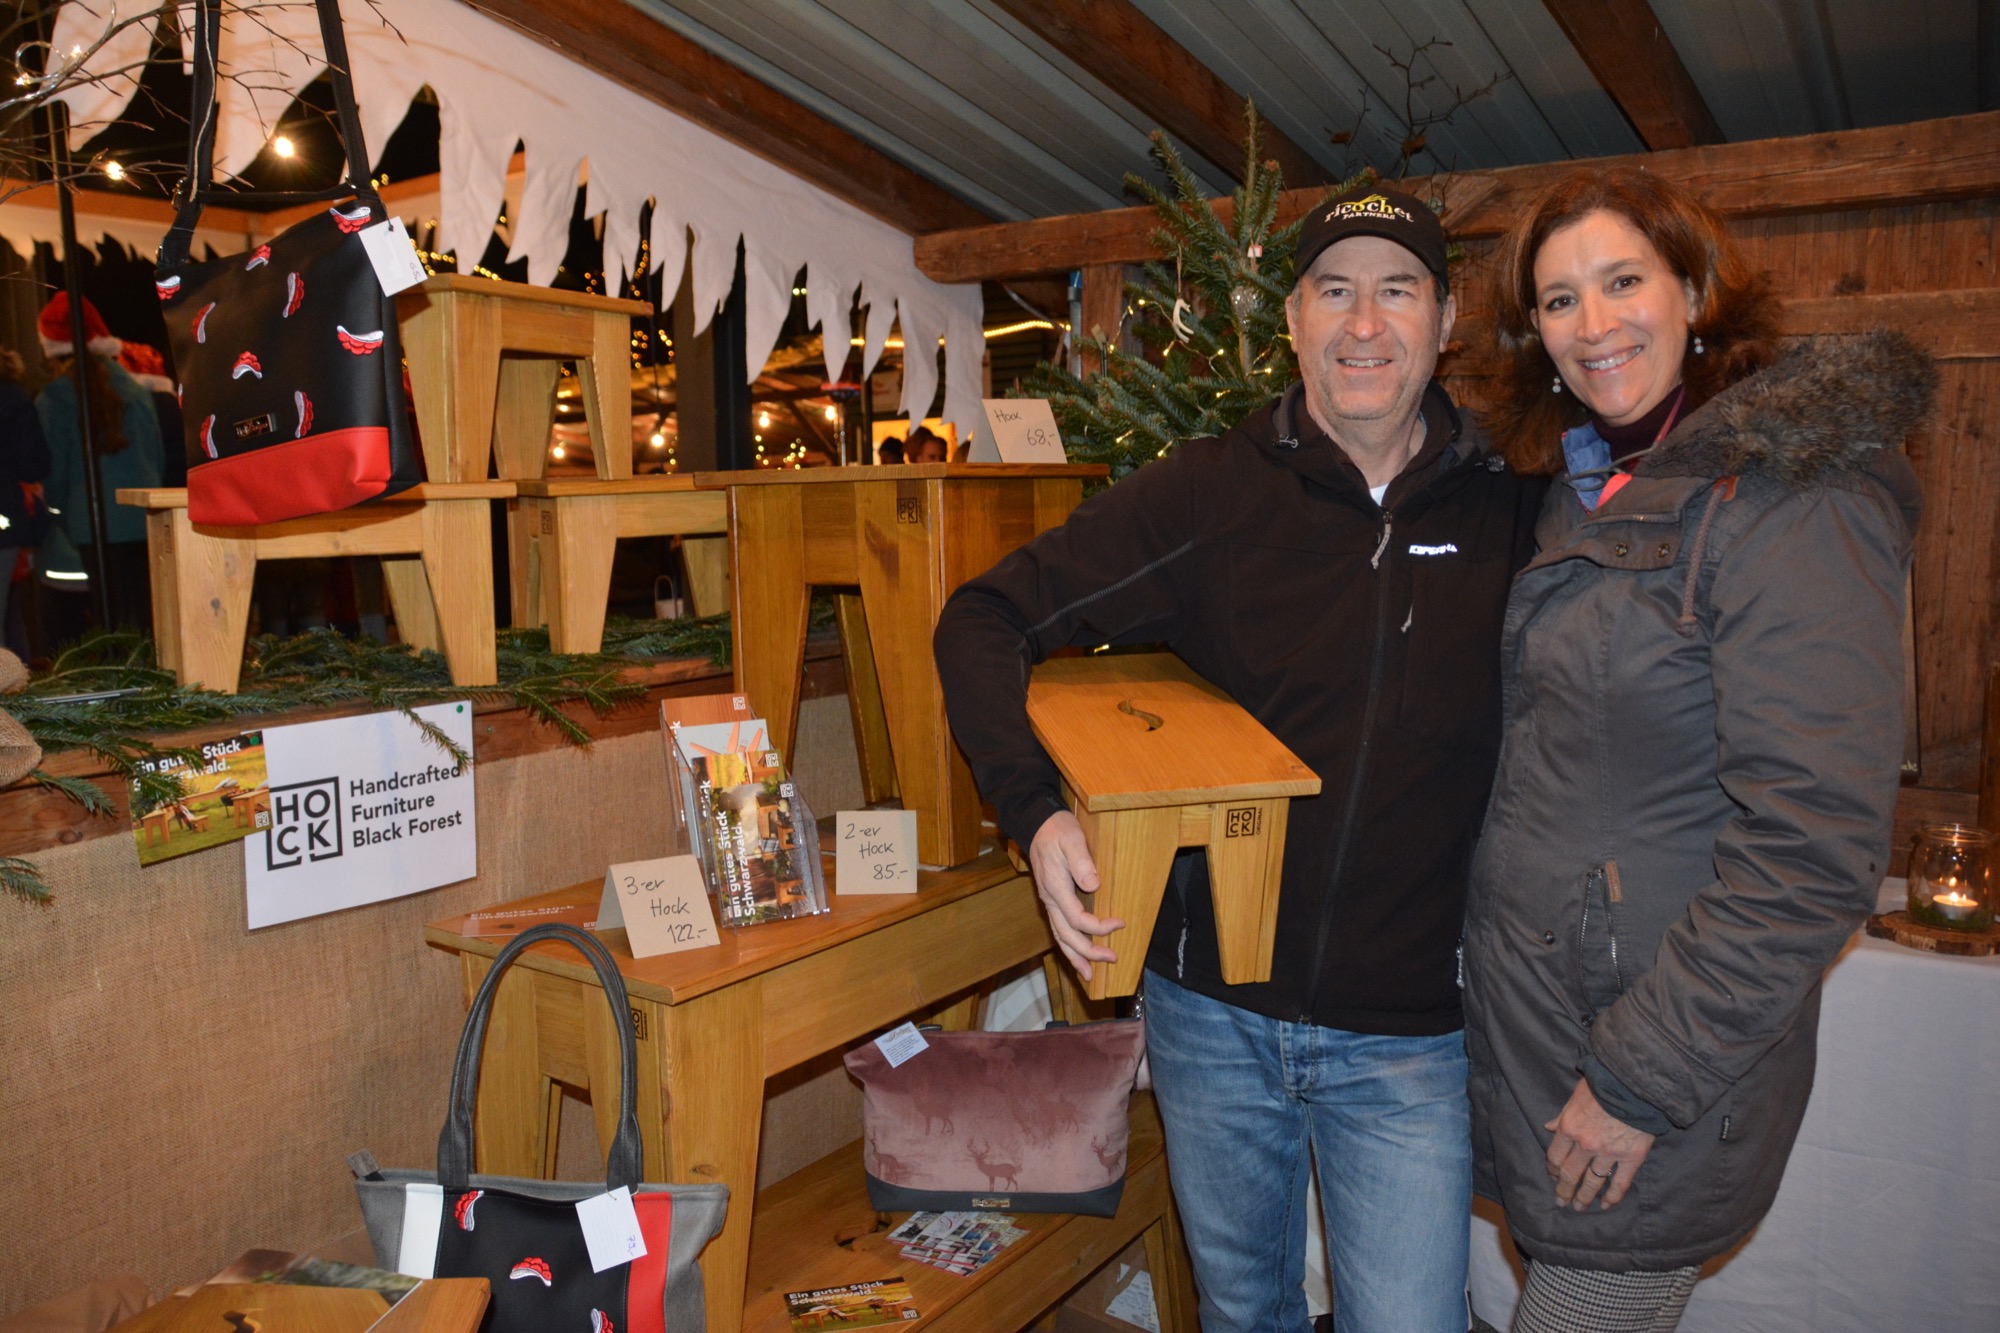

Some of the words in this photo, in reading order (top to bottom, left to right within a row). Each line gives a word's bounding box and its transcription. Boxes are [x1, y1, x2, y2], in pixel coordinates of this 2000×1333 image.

[1324, 200, 1414, 222] ricochet
[1342, 212, 1395, 220] PARTNERS
[994, 409, 1022, 423] Hock
[203, 740, 241, 759] Stück
[350, 762, 461, 797] Handcrafted
[352, 795, 435, 822] Furniture
[353, 822, 402, 847] Black
[409, 811, 462, 835] Forest
[716, 811, 731, 849] Stück
[845, 823, 881, 839] 2-er
[859, 841, 894, 859] Hock
[726, 853, 741, 892] gutes
[731, 822, 756, 916] Schwarzwald.
[623, 876, 665, 895] 3-er
[650, 897, 690, 917] Hock
[789, 1292, 809, 1300] Ein
[812, 1287, 848, 1297] gutes
[849, 1281, 884, 1291] Stück
